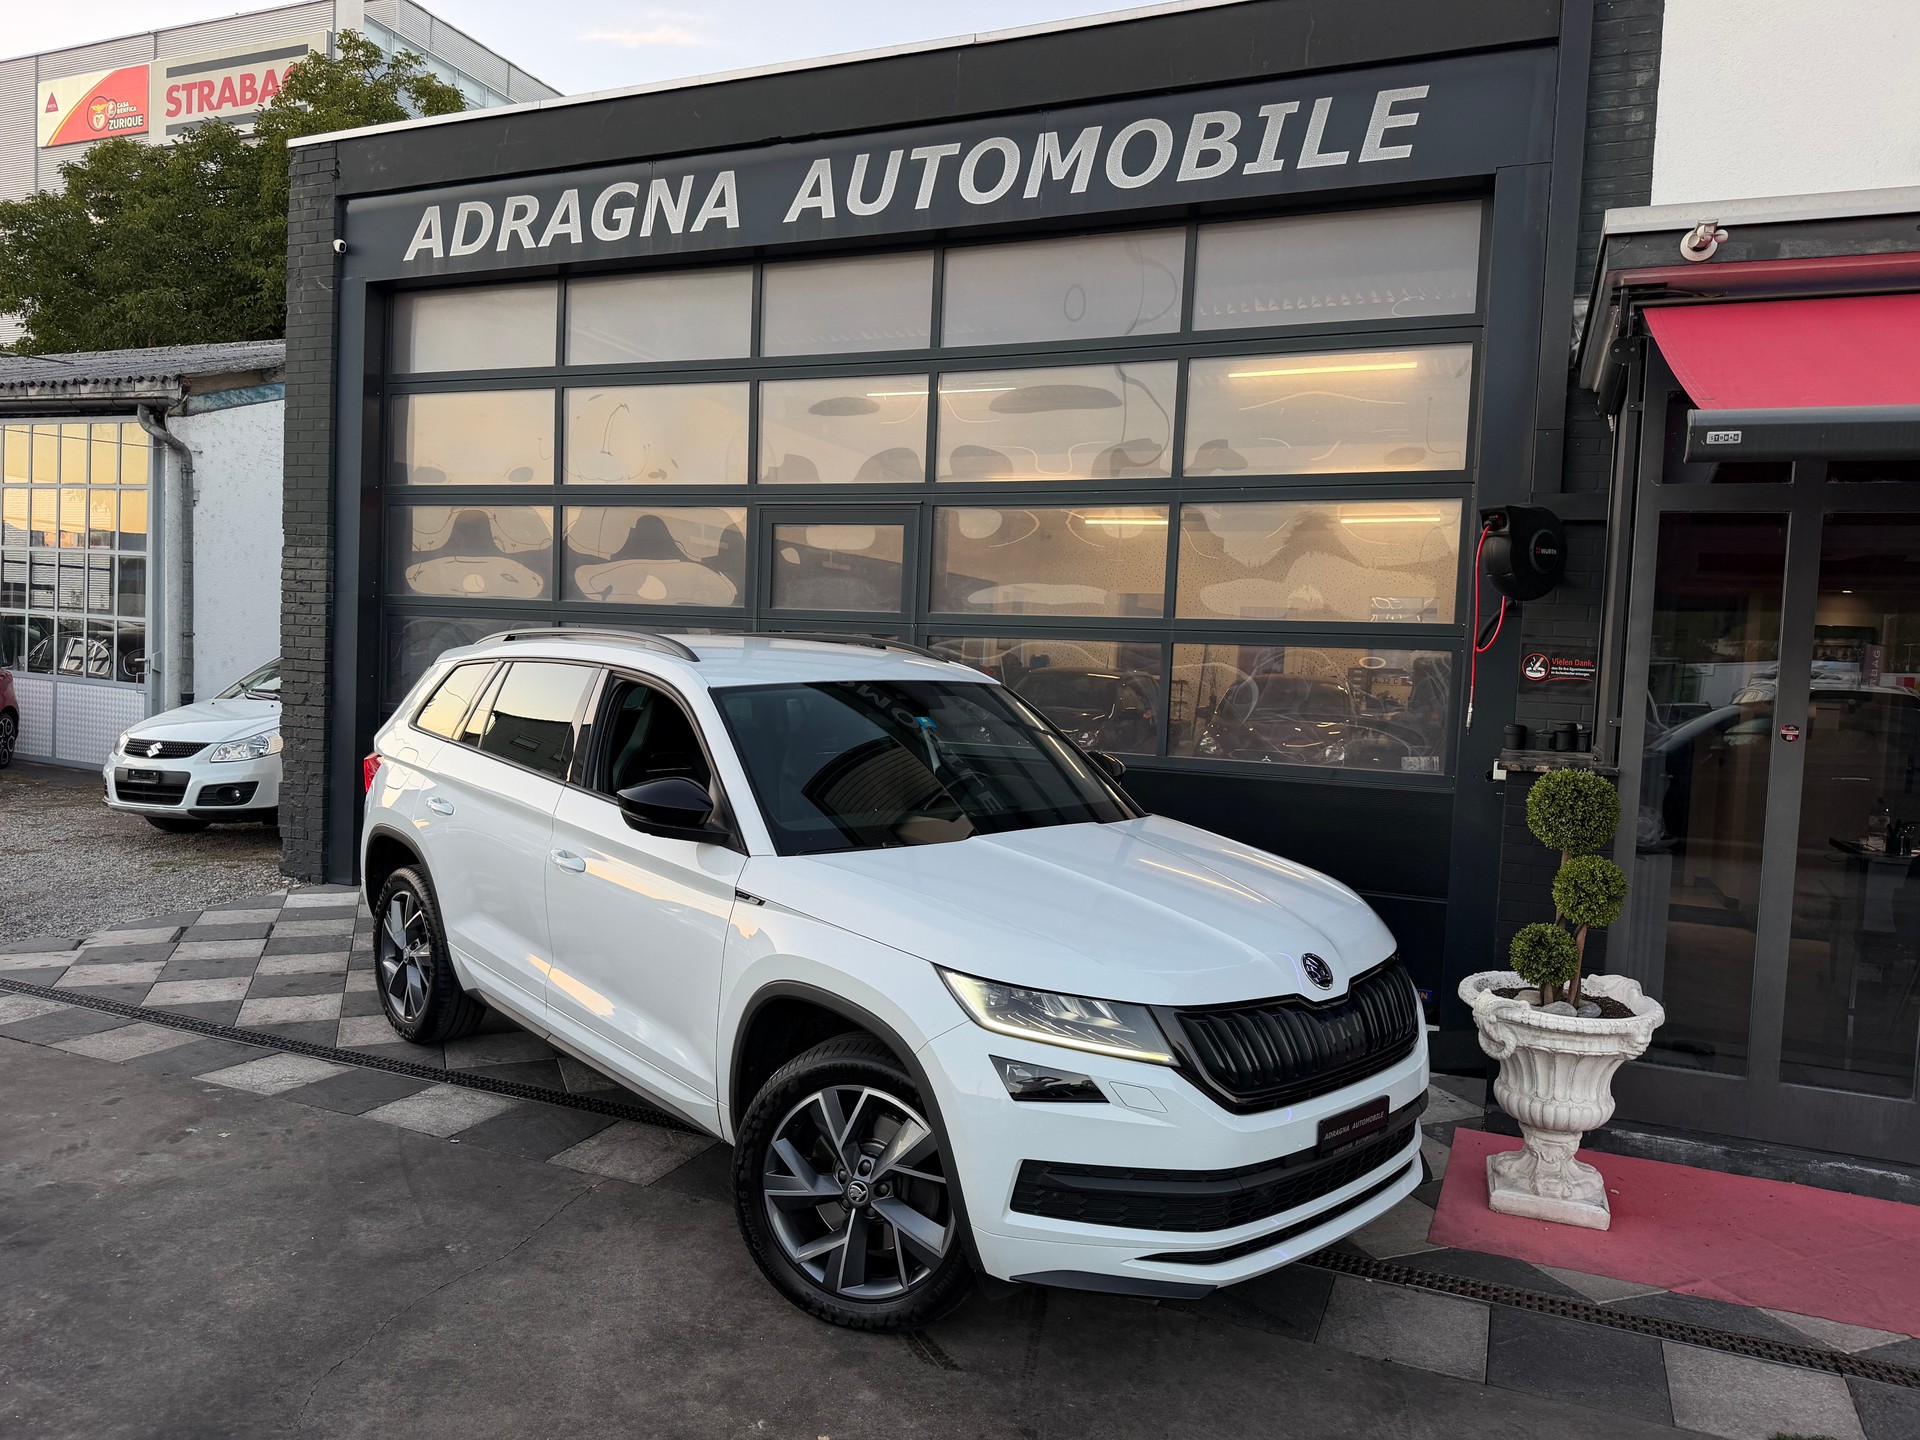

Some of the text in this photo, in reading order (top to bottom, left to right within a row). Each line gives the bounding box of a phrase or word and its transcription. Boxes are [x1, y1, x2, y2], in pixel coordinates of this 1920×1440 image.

[165, 65, 302, 118] STRABA
[117, 106, 136, 114] BENFICA
[108, 115, 144, 130] ZURIQUE
[403, 85, 1430, 261] ADRAGNA AUTOMOBILE
[1551, 657, 1573, 666] Vielen
[1324, 1110, 1385, 1140] ADRAGNA AUTOMOBILE
